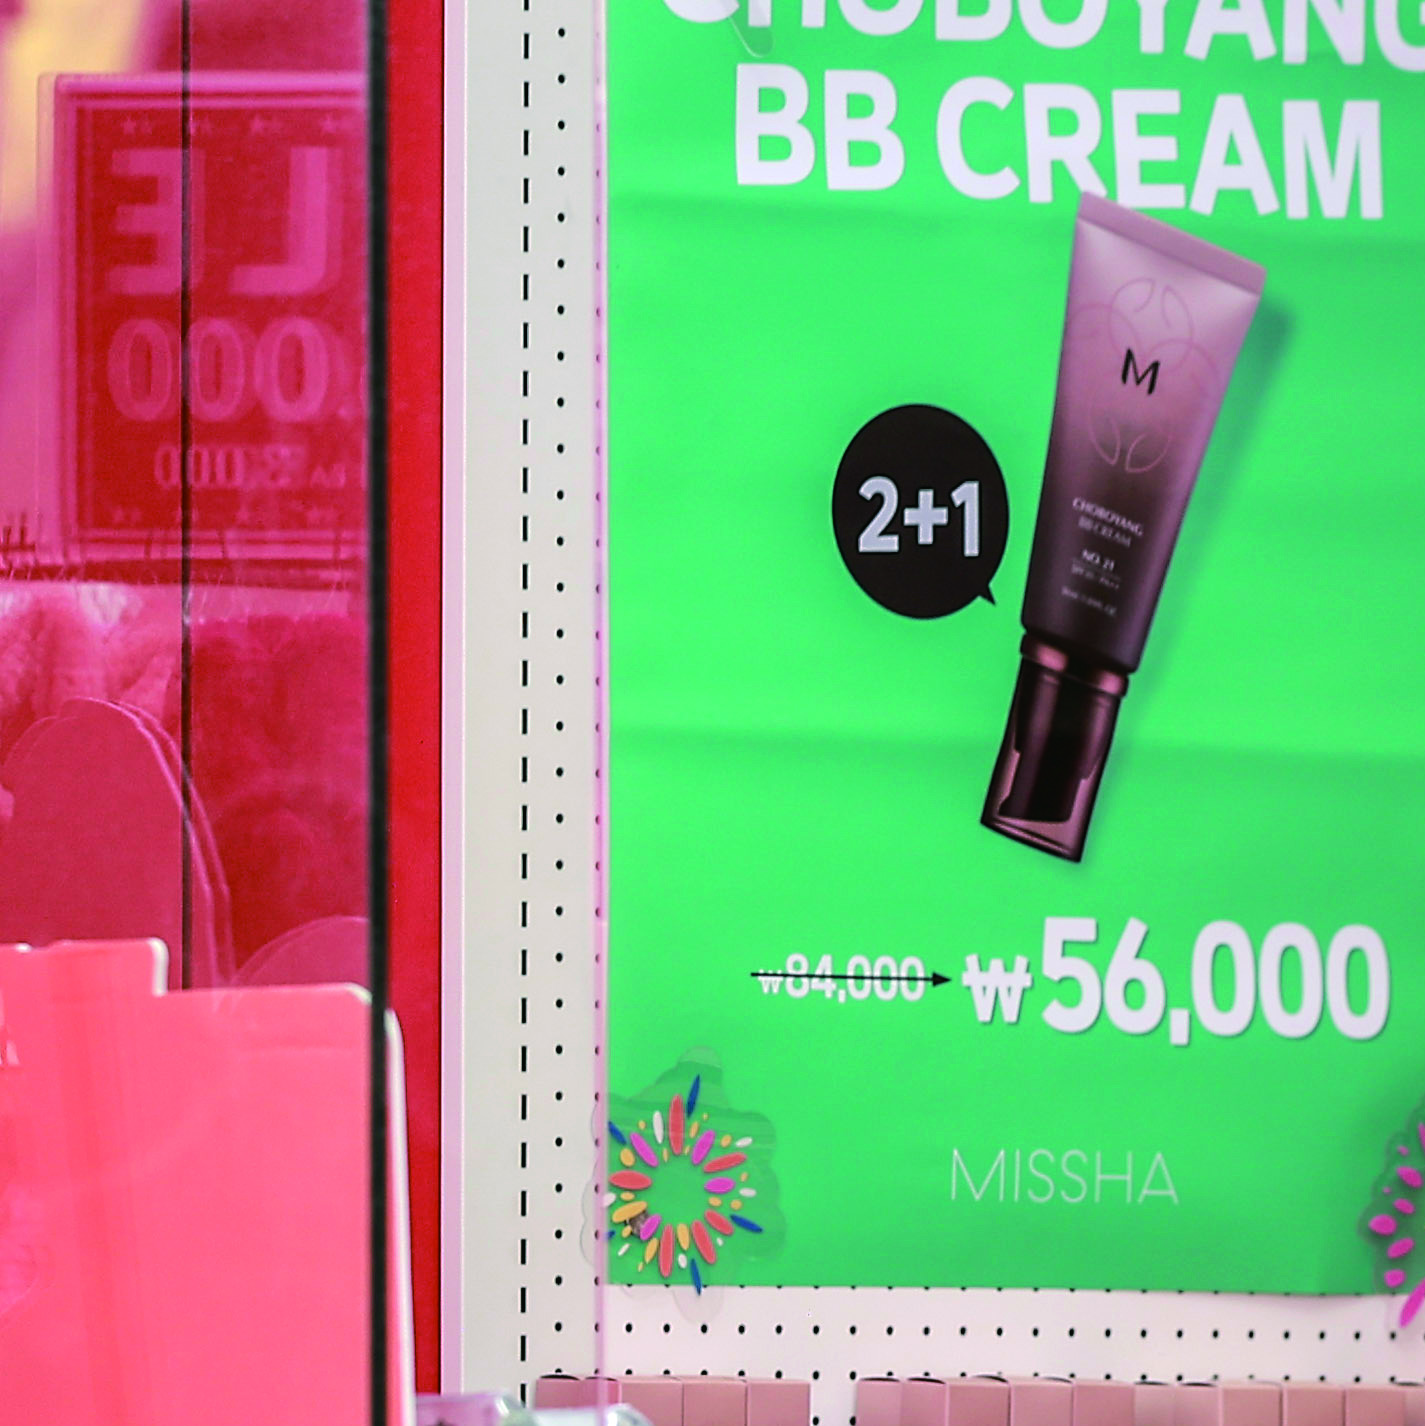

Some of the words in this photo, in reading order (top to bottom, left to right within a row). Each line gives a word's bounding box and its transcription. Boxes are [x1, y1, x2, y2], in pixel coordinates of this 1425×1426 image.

[735, 62, 906, 191] BB
[936, 75, 1383, 219] CREAM
[1121, 348, 1161, 396] M
[857, 476, 980, 557] 2+1
[951, 1148, 1180, 1205] MISSHA
